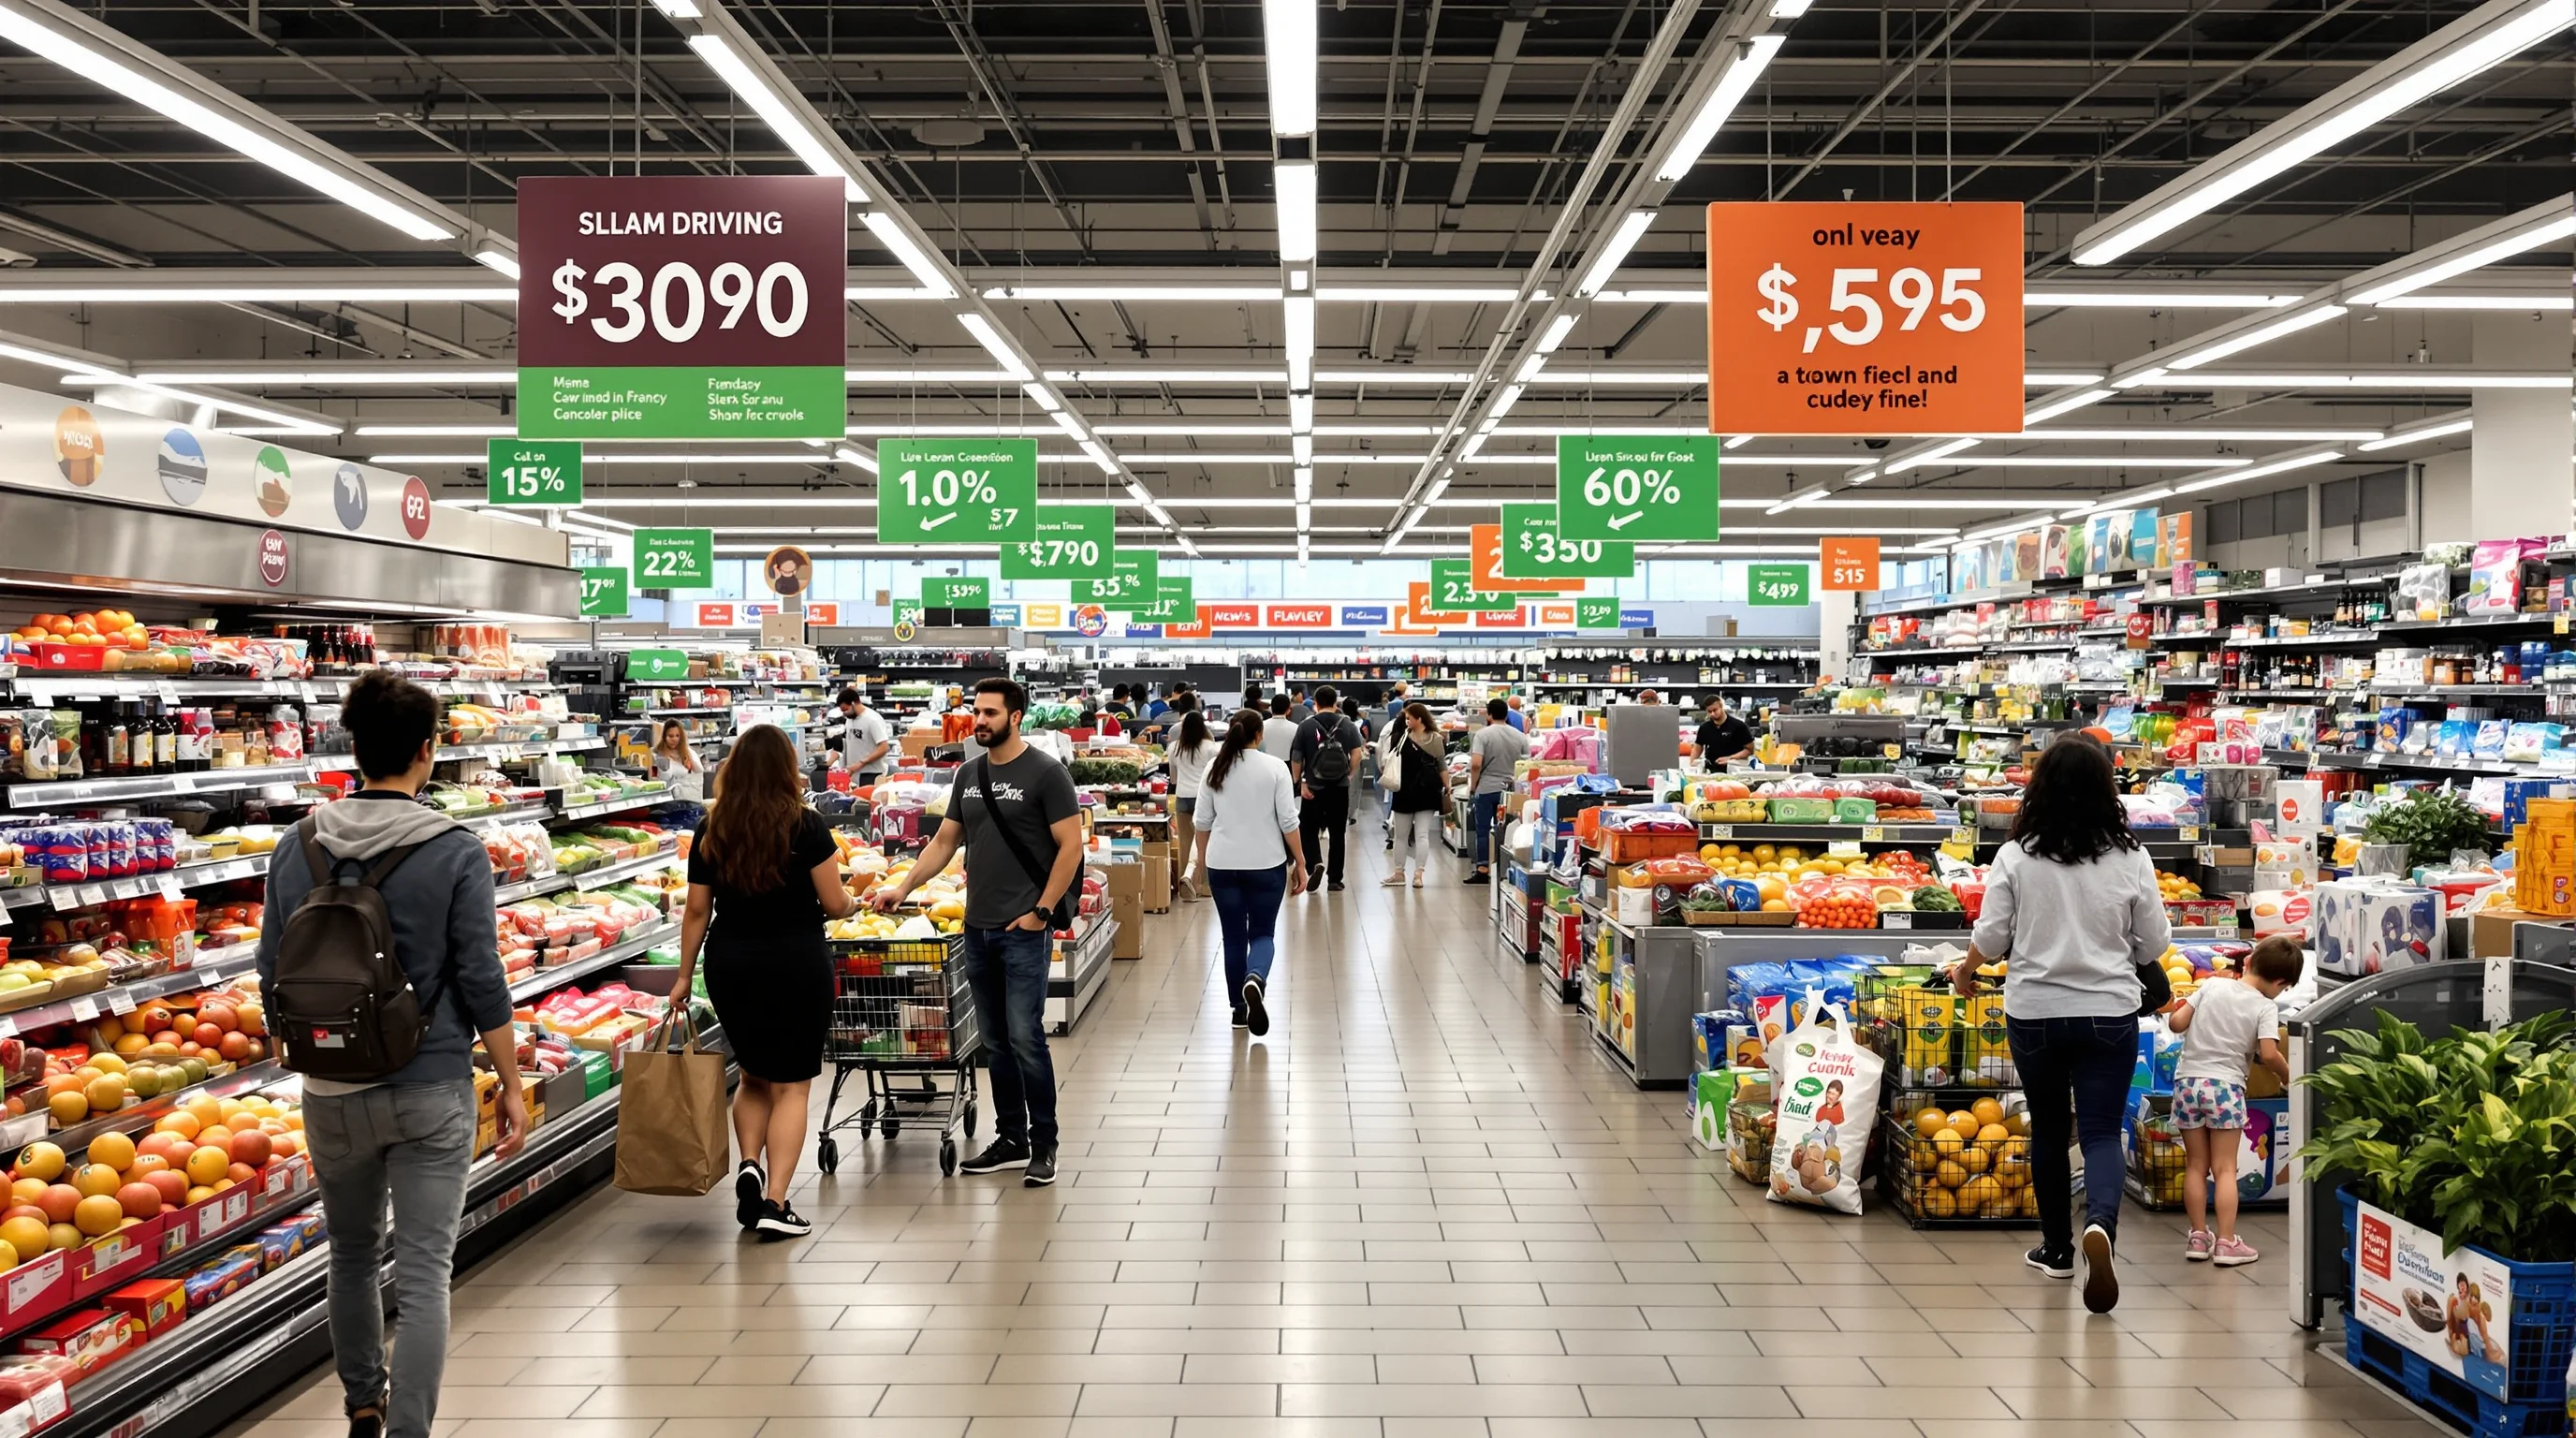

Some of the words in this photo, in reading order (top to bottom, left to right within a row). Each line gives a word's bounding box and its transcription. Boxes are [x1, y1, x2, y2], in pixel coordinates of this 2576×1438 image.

[578, 212, 666, 235] SLLAM
[672, 211, 783, 235] DRIVING
[1812, 223, 1852, 245] onl
[1860, 229, 1920, 250] veay
[551, 258, 809, 343] $3090
[1777, 369, 1789, 384] a
[1917, 365, 1957, 384] and
[1879, 389, 1928, 408] fine!
[502, 466, 564, 496] 15%
[899, 470, 997, 506] 1.0%
[1584, 466, 1680, 506] 60%
[1520, 530, 1602, 563] $350
[643, 550, 695, 576] 22%
